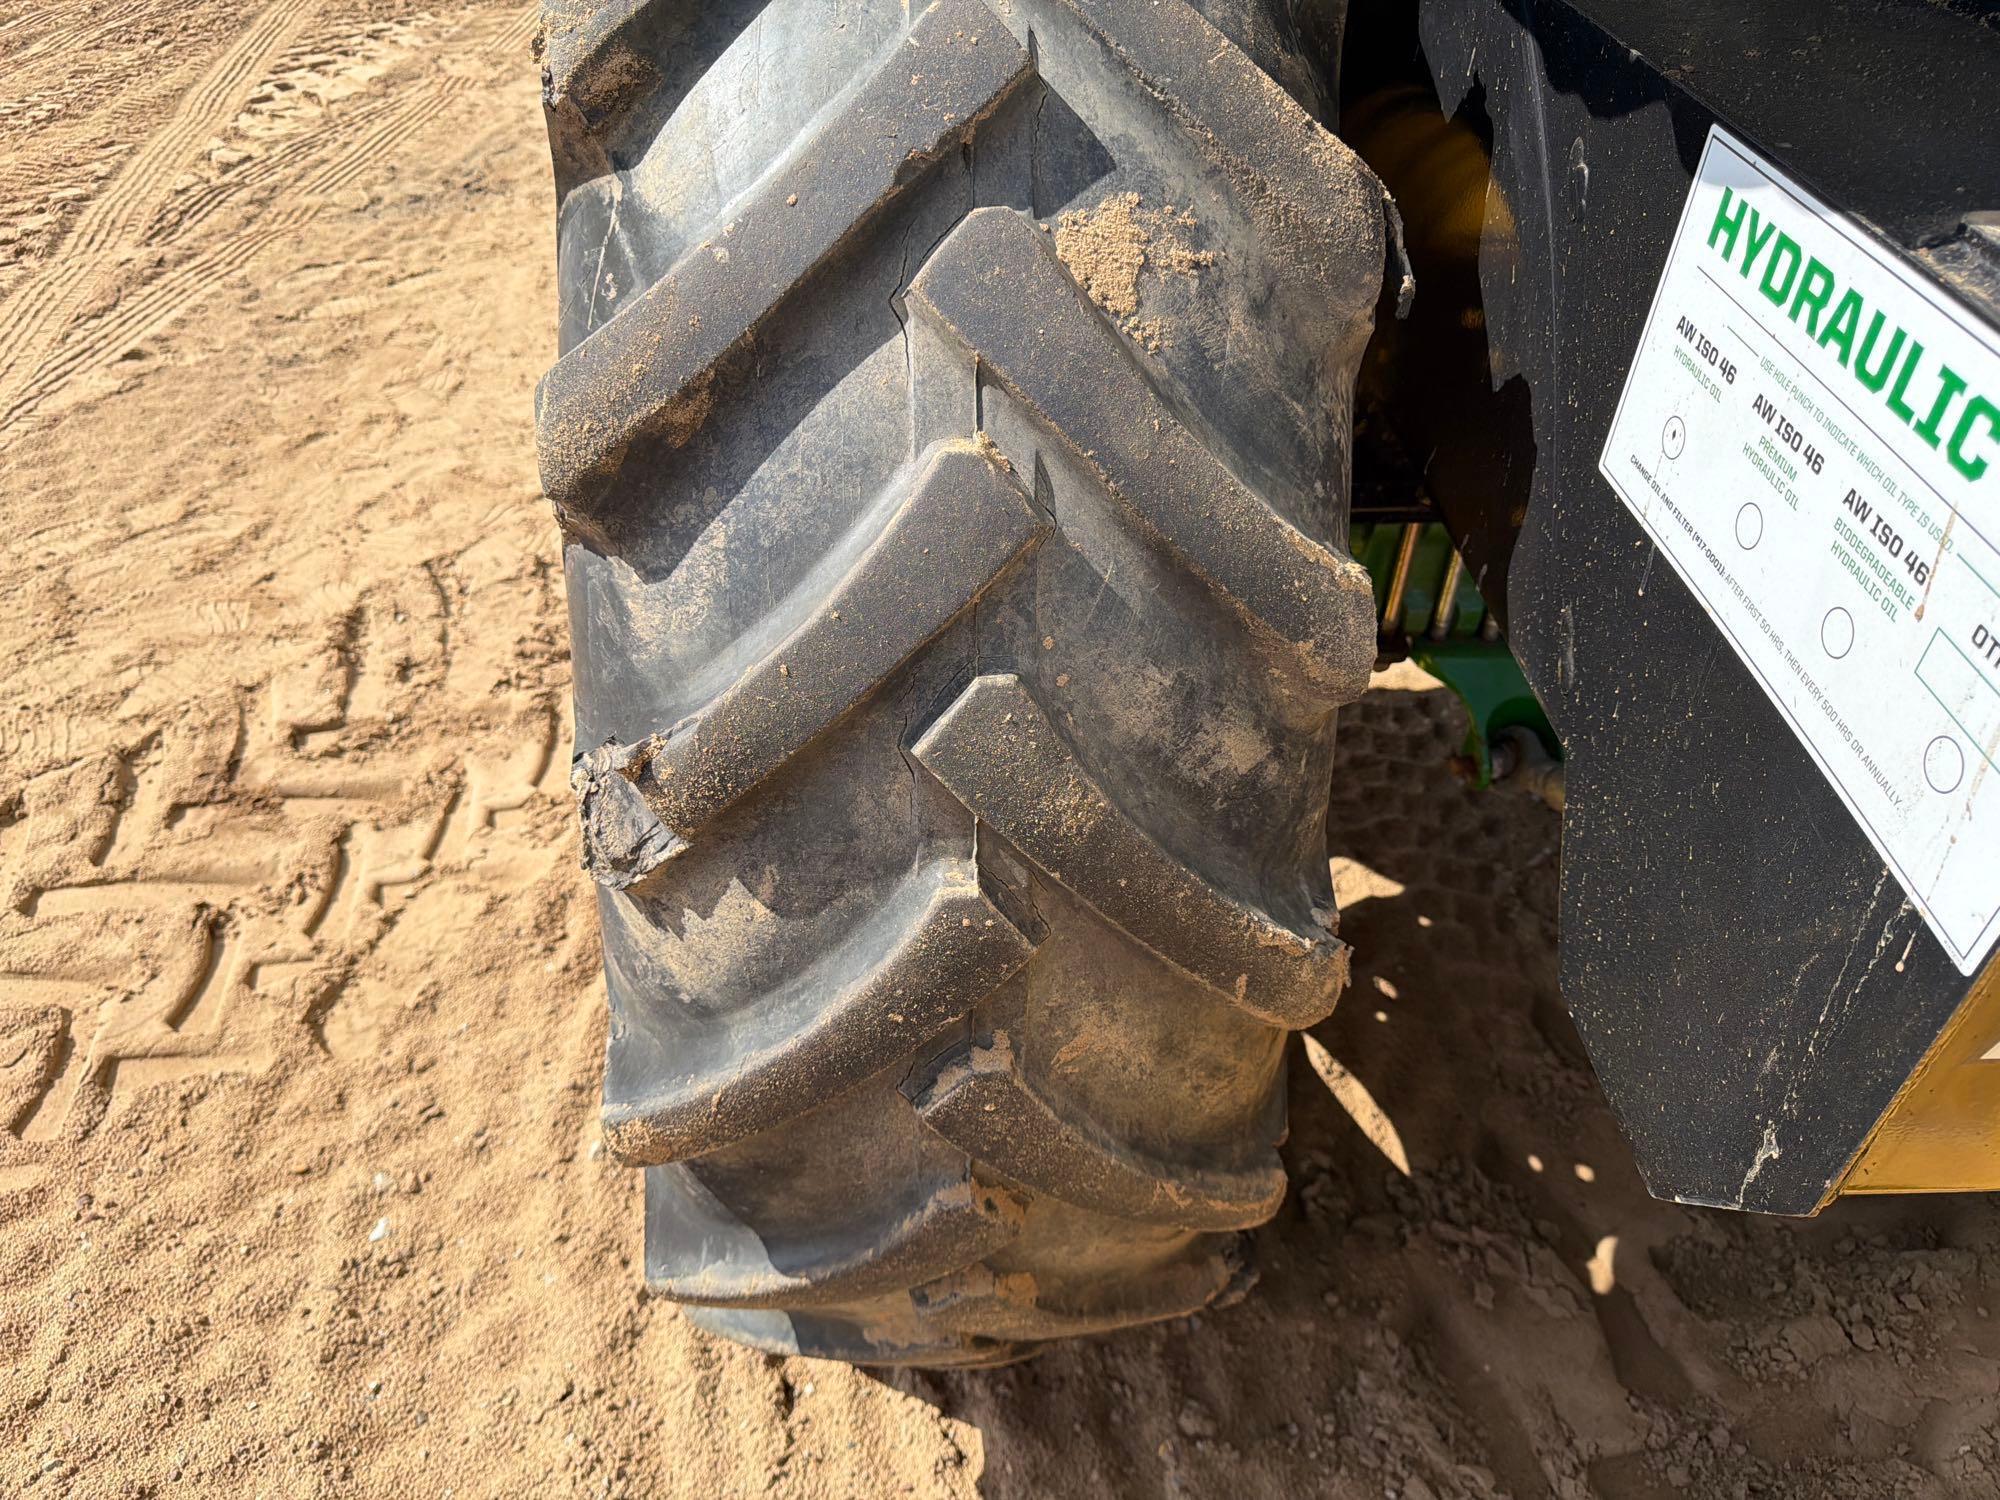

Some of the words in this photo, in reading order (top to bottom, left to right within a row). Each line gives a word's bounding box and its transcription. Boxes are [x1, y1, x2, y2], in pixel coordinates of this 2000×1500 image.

[1673, 345, 1711, 390] HYDRAULIC
[1709, 383, 1723, 404] OIL
[1676, 315, 1697, 344] AW
[1695, 332, 1718, 366] ISO
[1718, 357, 1737, 385] 46
[1707, 185, 2000, 482] HYDRAULIC
[1751, 393, 1778, 425] AW
[1774, 414, 1803, 453] ISO
[1802, 443, 1825, 475] 46
[1758, 435, 1798, 482] PREMIUM
[1759, 356, 1774, 375] USE
[1773, 367, 1792, 391] HOLE
[1790, 384, 1815, 413] PUNCH
[1812, 406, 1825, 423] TO
[1821, 416, 1858, 456] INDICATE
[1856, 450, 1885, 484] WHICH
[1882, 476, 1898, 498] OIL
[1897, 490, 1920, 518] TYPE
[1916, 511, 1930, 528] IS
[1927, 522, 1954, 555] USD.
[1742, 442, 1786, 494] HYDRAULIC
[1784, 489, 1799, 512] OIL
[1833, 516, 1915, 611] BIODEGRADEABLE
[1842, 487, 1873, 524] AW
[1869, 514, 1904, 558] ISO
[1903, 549, 1930, 586] 46
[1830, 540, 1882, 602] HYDRAULIC
[1880, 596, 1900, 623] OIL
[1630, 454, 1653, 484] CHANGE
[1651, 480, 1662, 497] OIL
[1660, 493, 1674, 511] AND
[1672, 507, 1693, 536] FILTER
[1724, 574, 1745, 600] AFTER
[1742, 595, 1763, 623] FIRST
[1760, 617, 1771, 634] 50
[1768, 629, 1785, 655] HRS,
[1784, 649, 1803, 676] THEN
[1800, 671, 1823, 702] EVERY
[1820, 699, 1838, 722] 500
[1836, 718, 1854, 742] HRS
[1851, 738, 1865, 759] OR
[1860, 754, 1903, 812] ANNUALLY.
